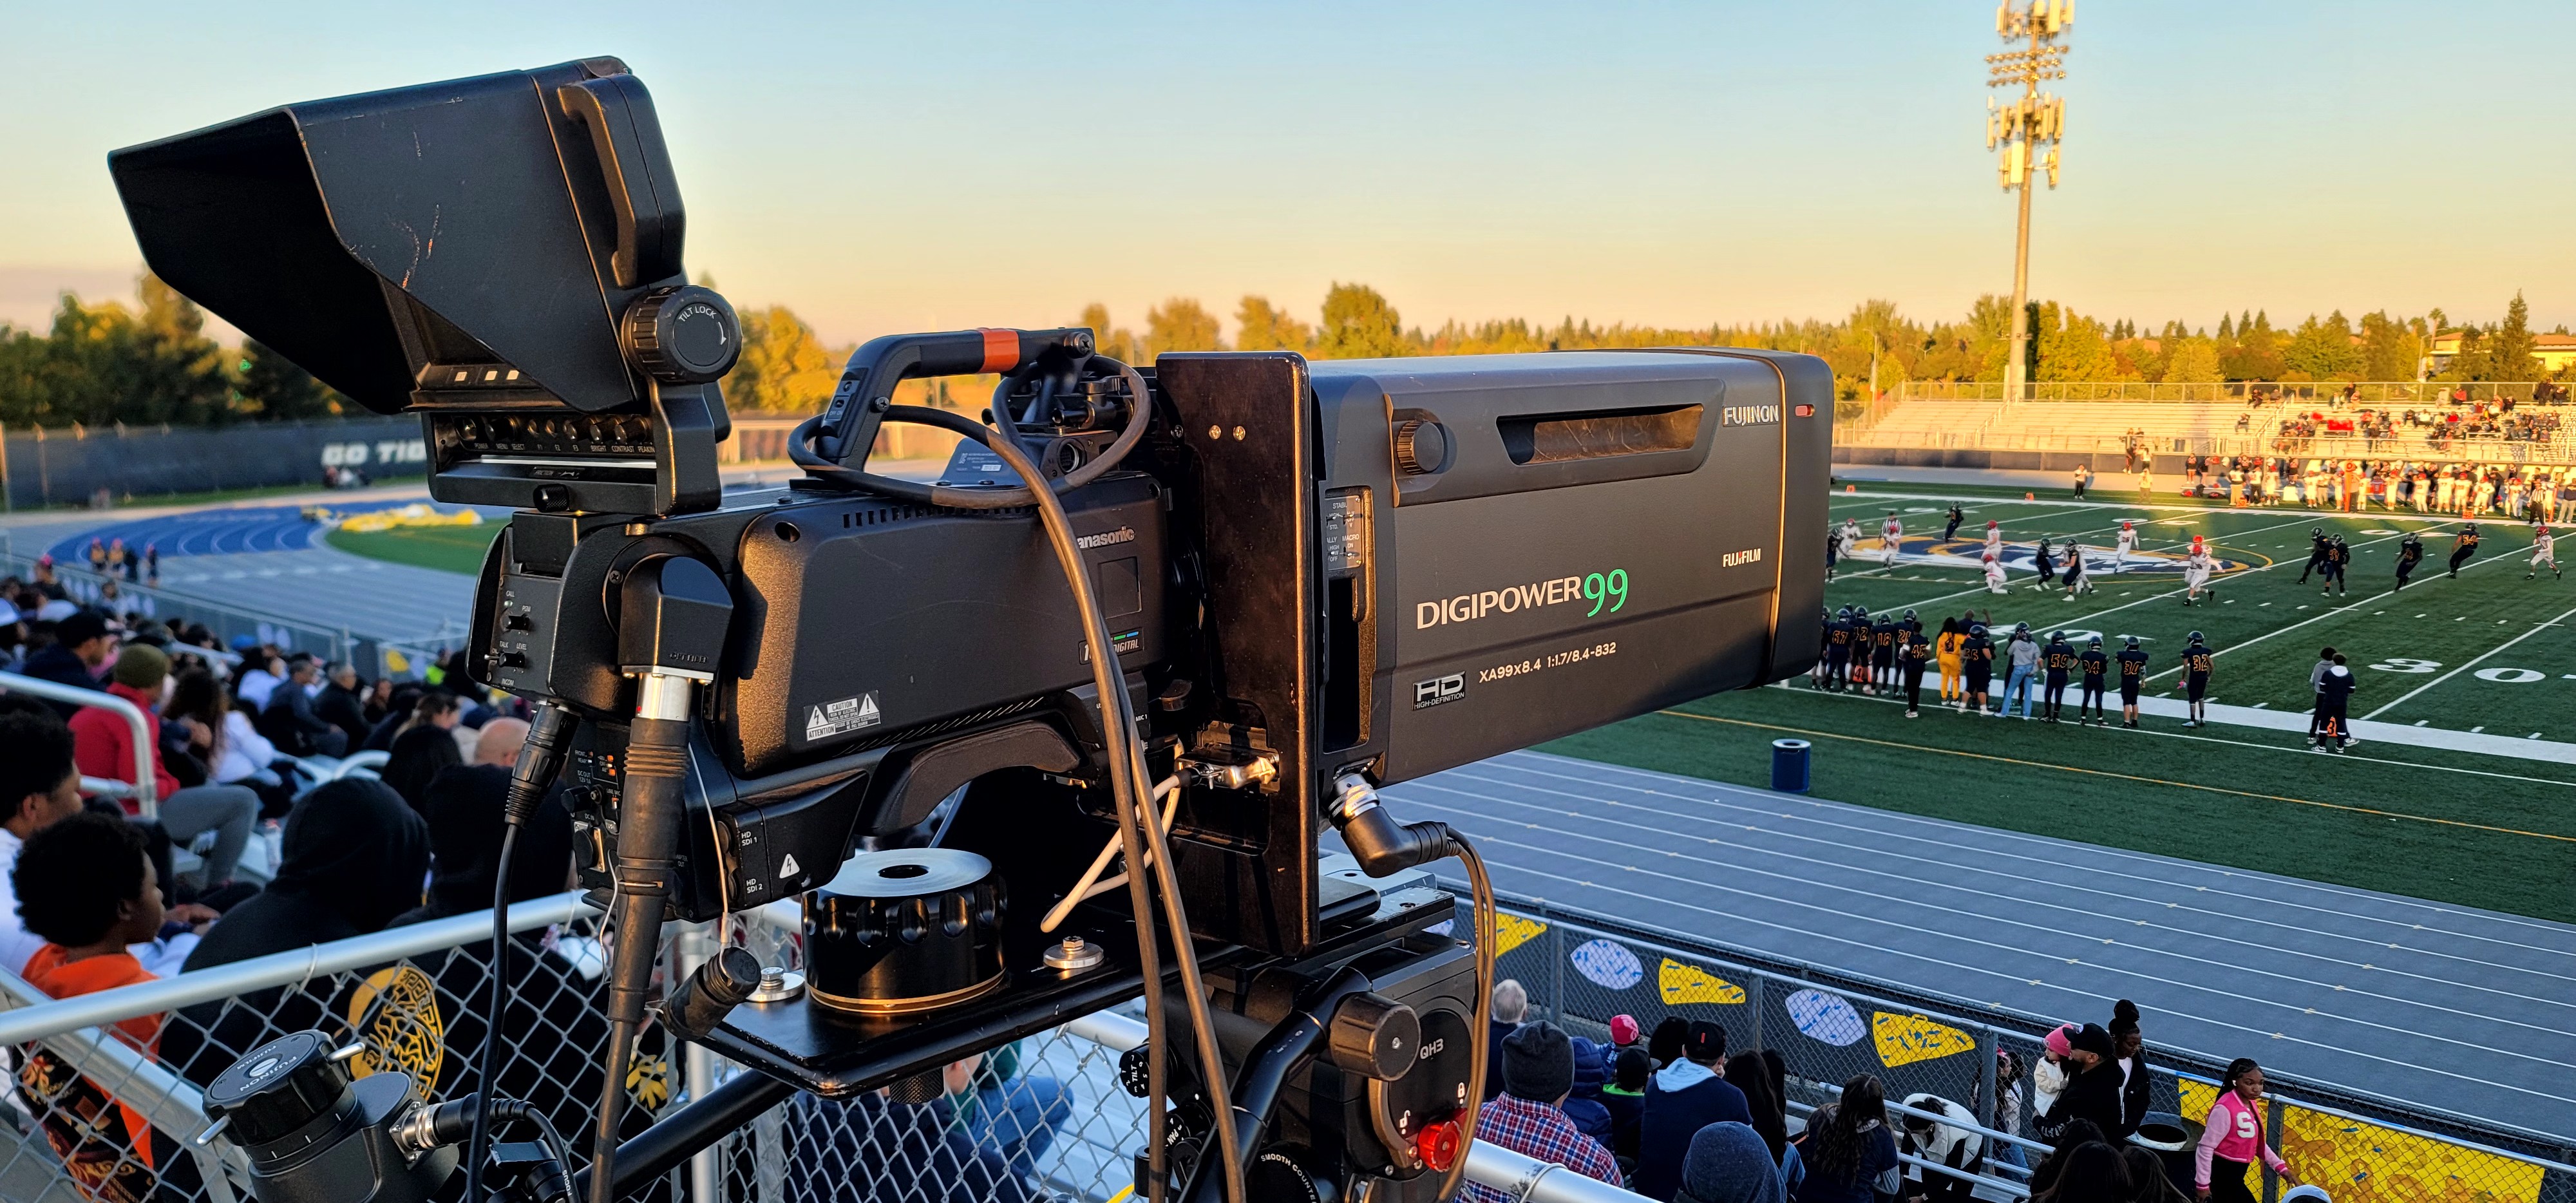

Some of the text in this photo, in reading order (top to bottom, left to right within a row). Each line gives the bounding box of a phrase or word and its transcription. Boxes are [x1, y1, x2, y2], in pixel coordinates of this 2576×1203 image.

[678, 305, 717, 322] TILT LOCK
[1724, 404, 1779, 426] FUJINON
[1077, 525, 1135, 549] anasonic
[1723, 548, 1761, 567] FUJIFILM
[1547, 641, 1617, 668] 1:1.7/8.4-832
[2474, 667, 2546, 683] 0
[1416, 674, 1464, 701] HD
[832, 701, 853, 712] CAUTION
[1414, 691, 1465, 710] HIGH-DEFINITION
[809, 726, 834, 739] ATTENTION
[741, 831, 752, 839] HD
[746, 878, 757, 886] HD
[1420, 1038, 1444, 1059] QH3
[240, 1056, 298, 1092] FUJINON
[2237, 1112, 2256, 1139] S
[1167, 1129, 1179, 1145] PAN
[562, 1170, 573, 1197] FOCUS
[1260, 1153, 1317, 1203] SMOOTH COUNTE
